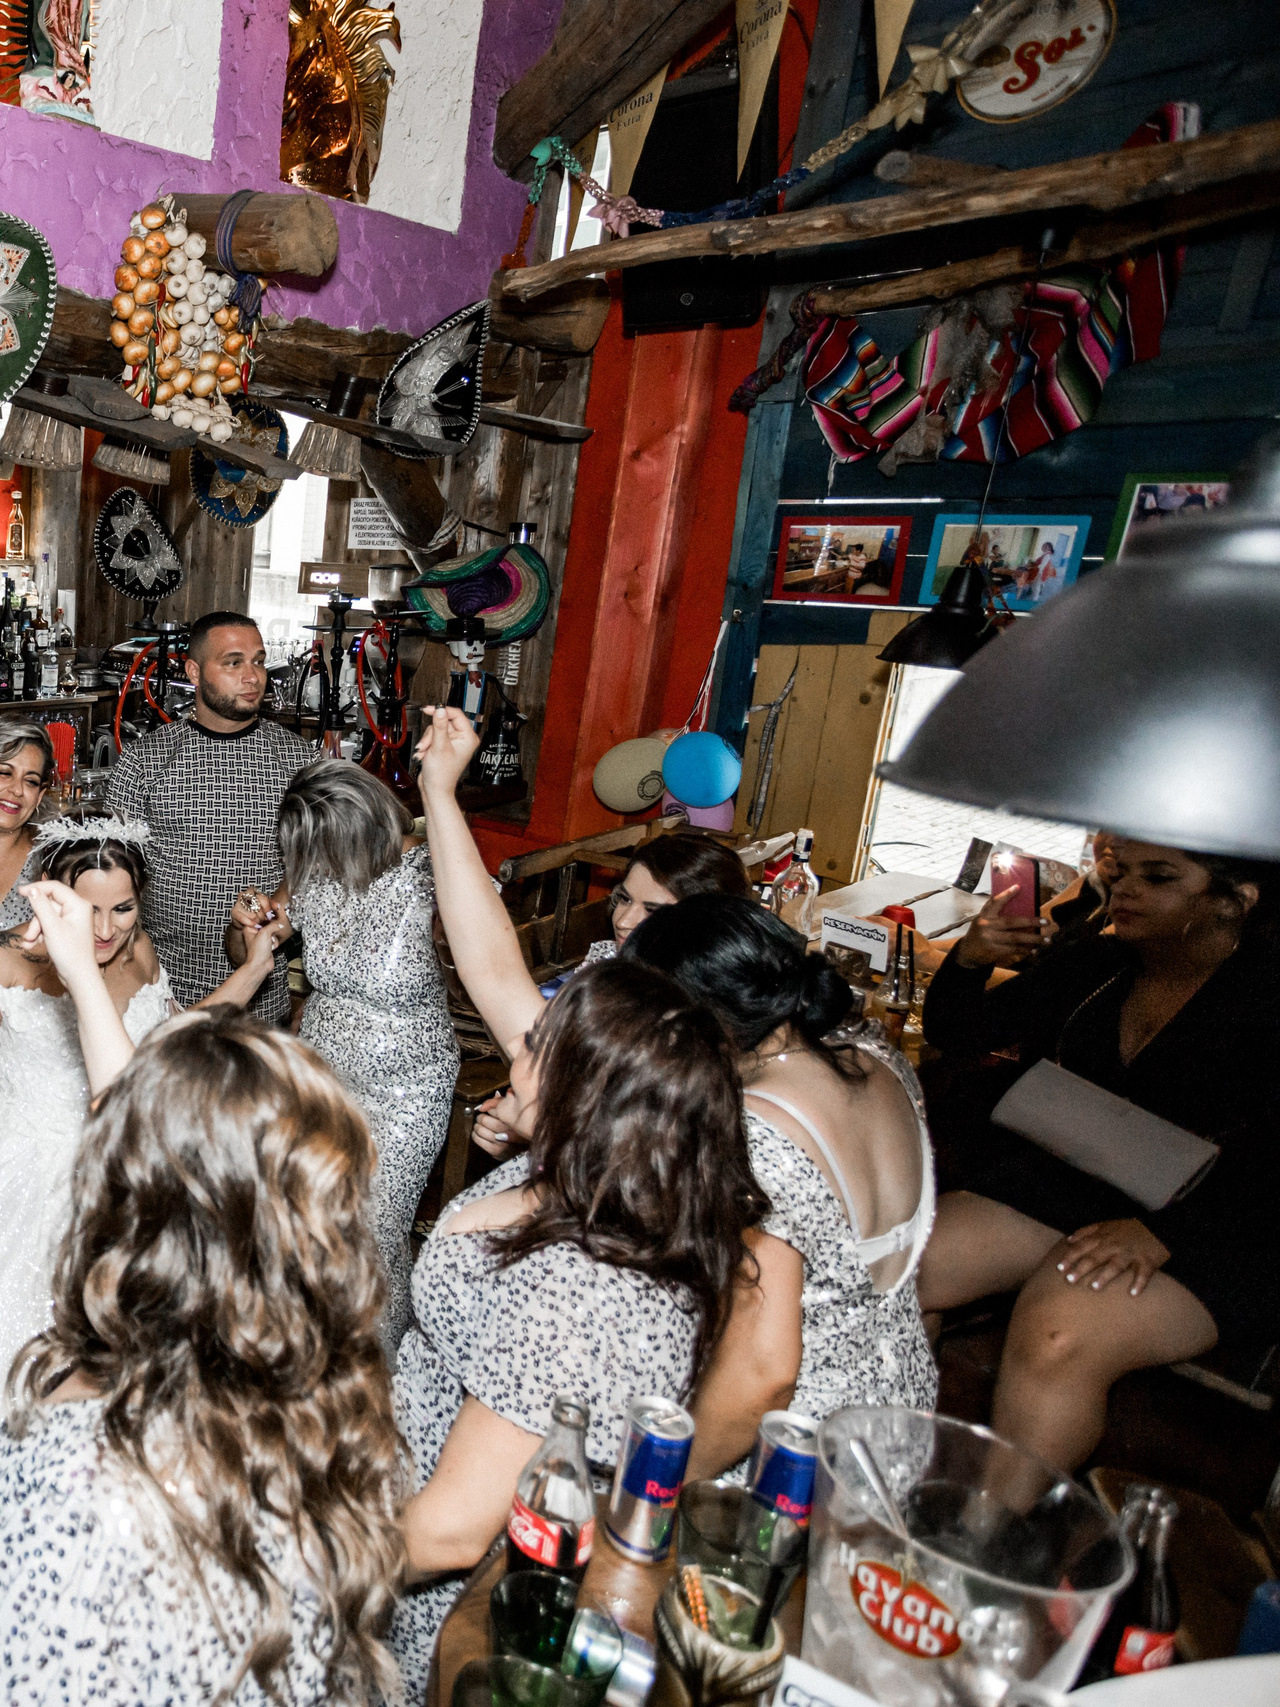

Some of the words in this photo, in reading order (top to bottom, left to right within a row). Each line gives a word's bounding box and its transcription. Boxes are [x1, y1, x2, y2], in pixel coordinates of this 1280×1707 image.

[739, 2, 783, 45] Corona
[744, 29, 770, 53] Extra
[609, 91, 654, 124] Corona
[616, 114, 642, 132] Extra
[823, 915, 887, 943] RESERVACIÓN
[839, 1541, 983, 1643] Havana
[858, 1590, 942, 1656] Club
